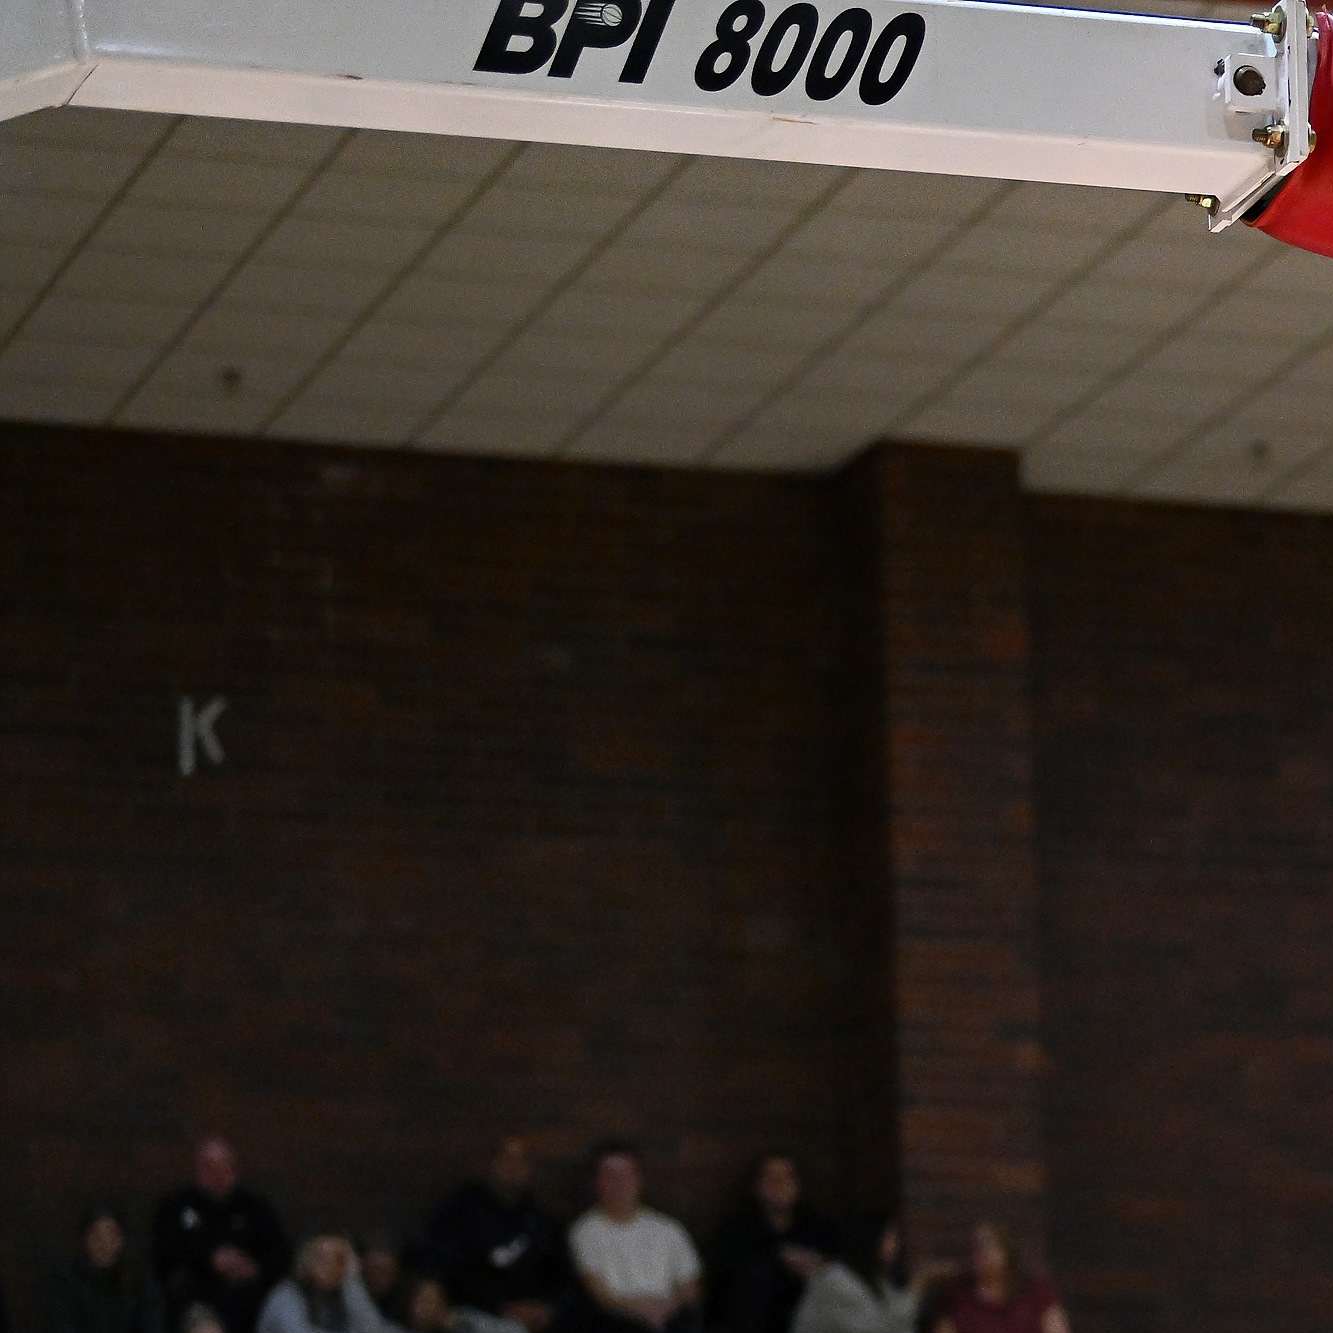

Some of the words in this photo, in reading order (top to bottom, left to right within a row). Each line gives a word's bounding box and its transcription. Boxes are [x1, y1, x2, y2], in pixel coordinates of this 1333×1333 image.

[473, 0, 675, 84] BPI
[694, 0, 925, 106] 8000
[179, 697, 226, 775] K
